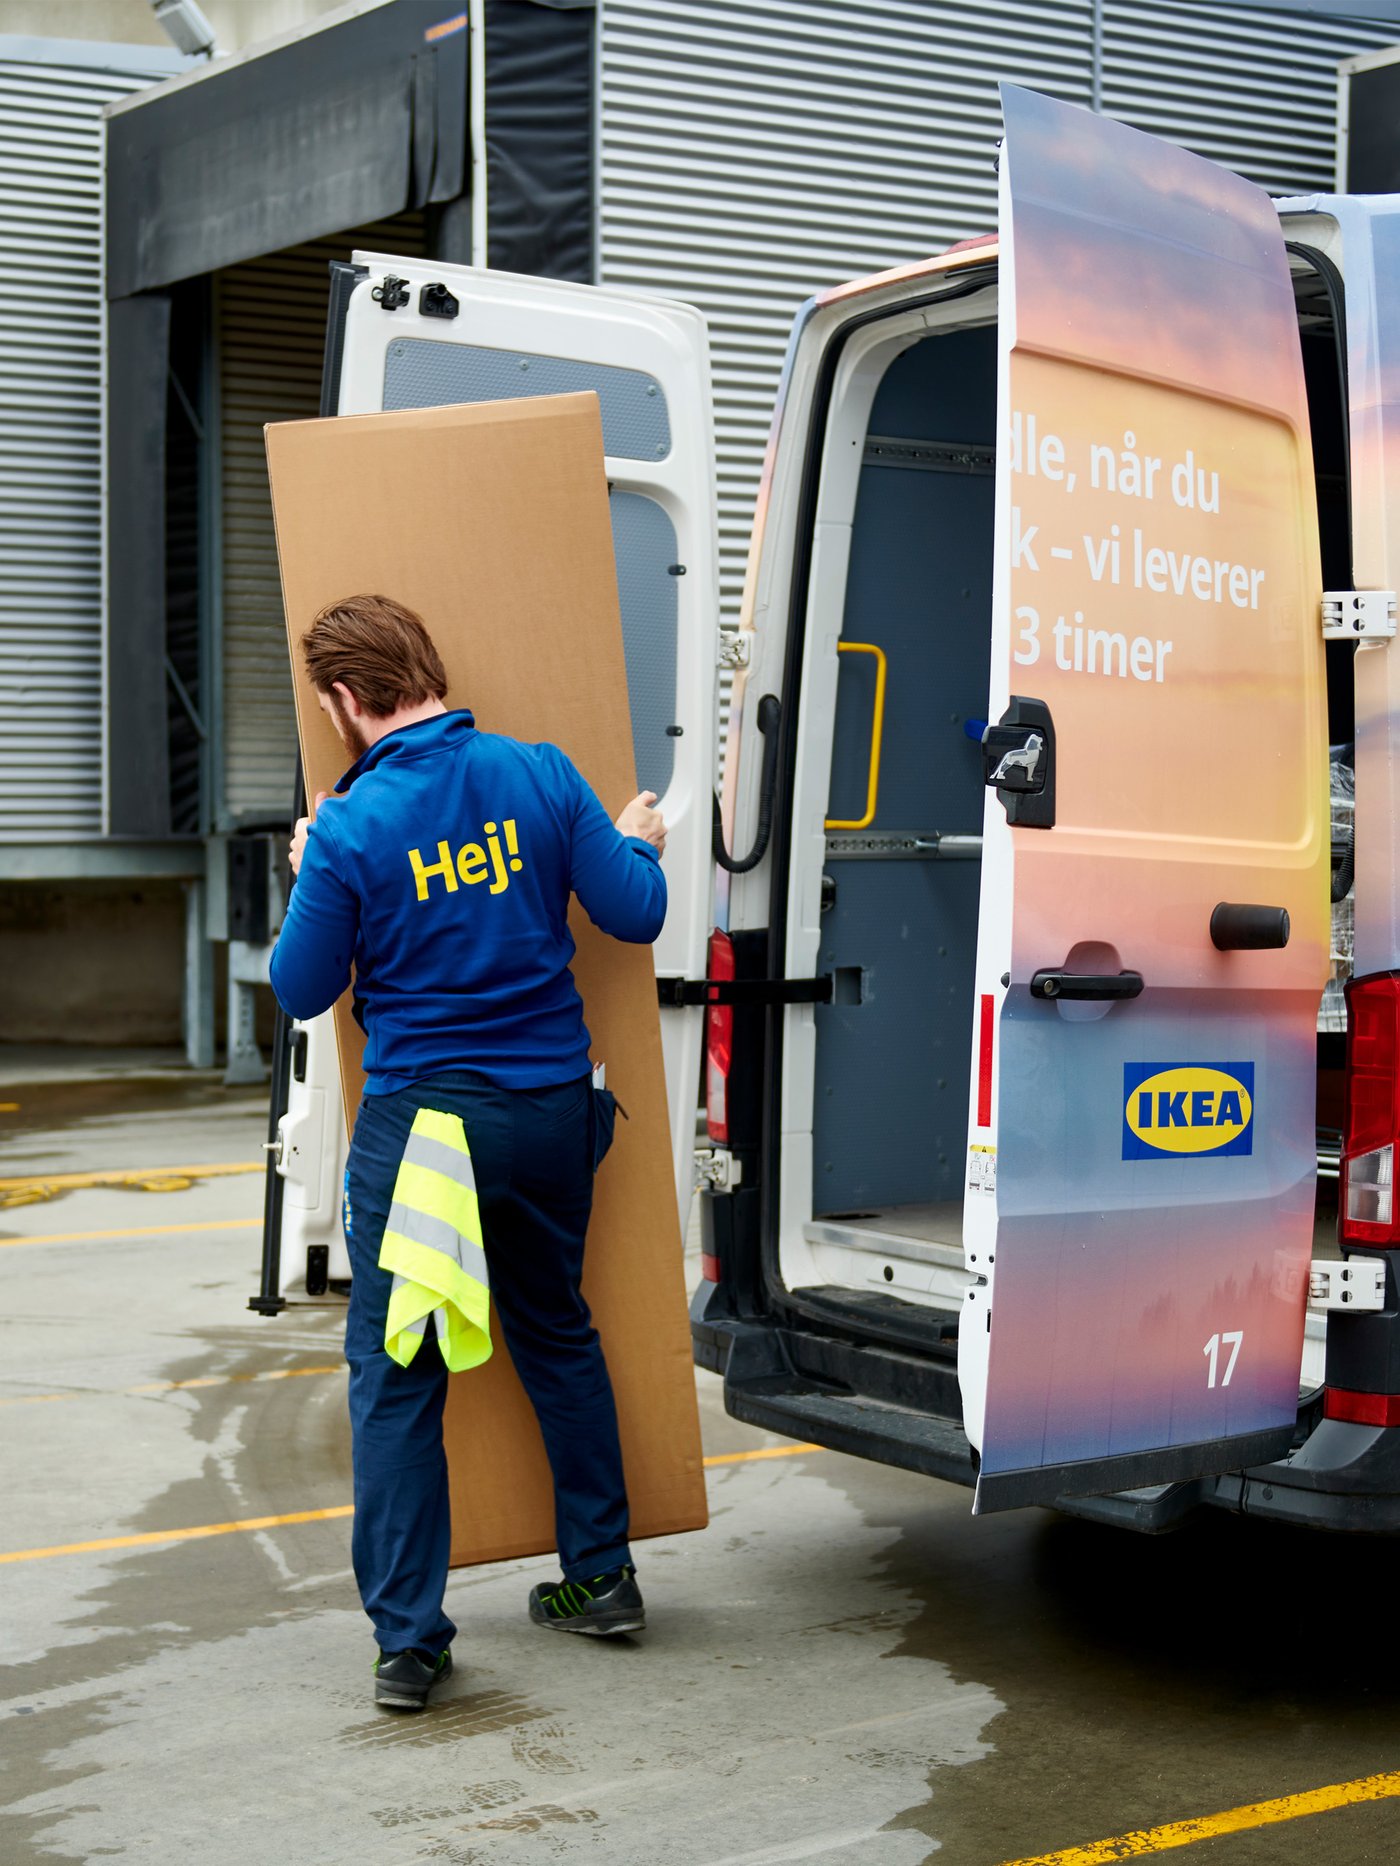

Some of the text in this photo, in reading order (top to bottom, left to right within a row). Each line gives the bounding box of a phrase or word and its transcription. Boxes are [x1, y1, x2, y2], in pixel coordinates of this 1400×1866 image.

[1090, 430, 1161, 499] når
[1171, 450, 1219, 514] du
[1083, 525, 1120, 584] vi
[1133, 528, 1265, 609] leverer
[1014, 606, 1173, 683] 3 timer
[408, 819, 523, 902] Hej!
[1138, 1091, 1243, 1128] IKEA
[1203, 1330, 1243, 1388] 17
